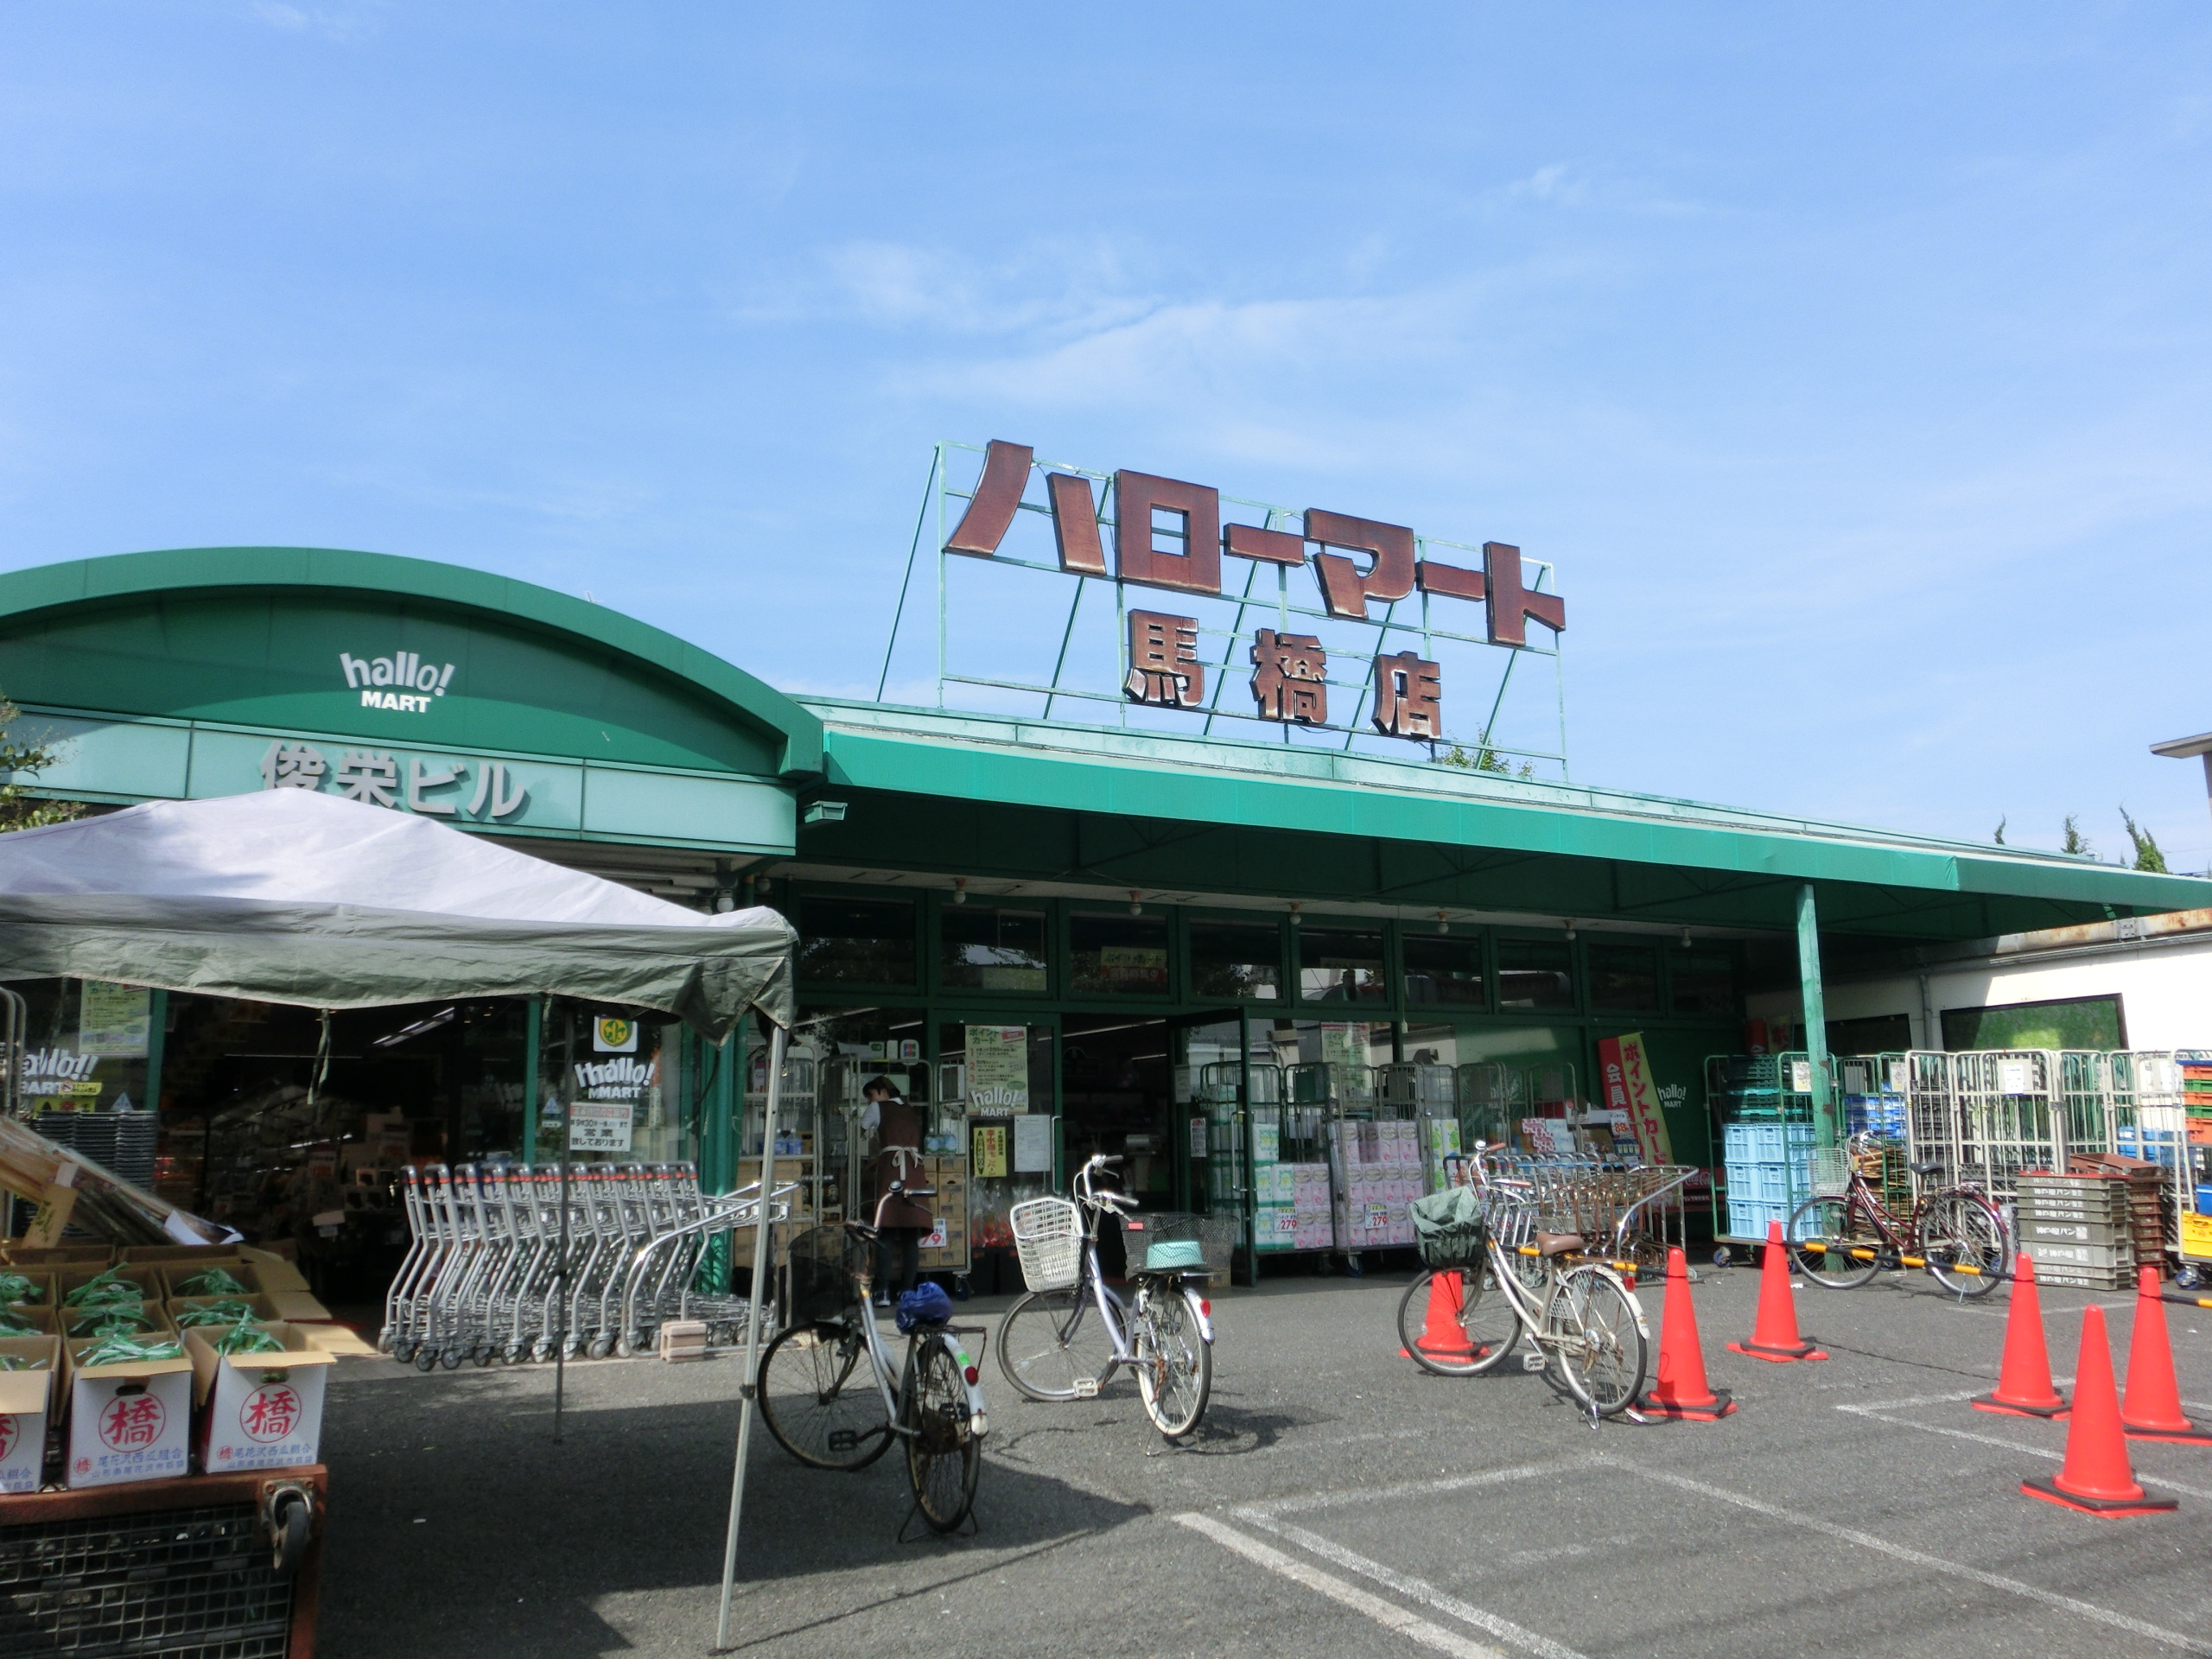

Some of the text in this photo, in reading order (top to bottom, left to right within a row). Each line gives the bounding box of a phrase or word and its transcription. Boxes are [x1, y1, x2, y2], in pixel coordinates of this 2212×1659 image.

[943, 439, 1566, 647] ハローマート
[340, 651, 456, 697] hallo!
[1123, 609, 1441, 741] 馬橋店
[361, 690, 431, 714] MART
[969, 1027, 999, 1039] ポイント
[970, 1086, 1020, 1108] hallo!
[1624, 1041, 1667, 1166] ポイントカード
[1657, 1084, 1687, 1101] hallo!
[980, 1107, 1009, 1116] MART
[1281, 1219, 1297, 1230] 279
[1372, 1216, 1388, 1227] 279
[104, 1396, 162, 1446] 橋
[244, 1389, 298, 1435] 橋
